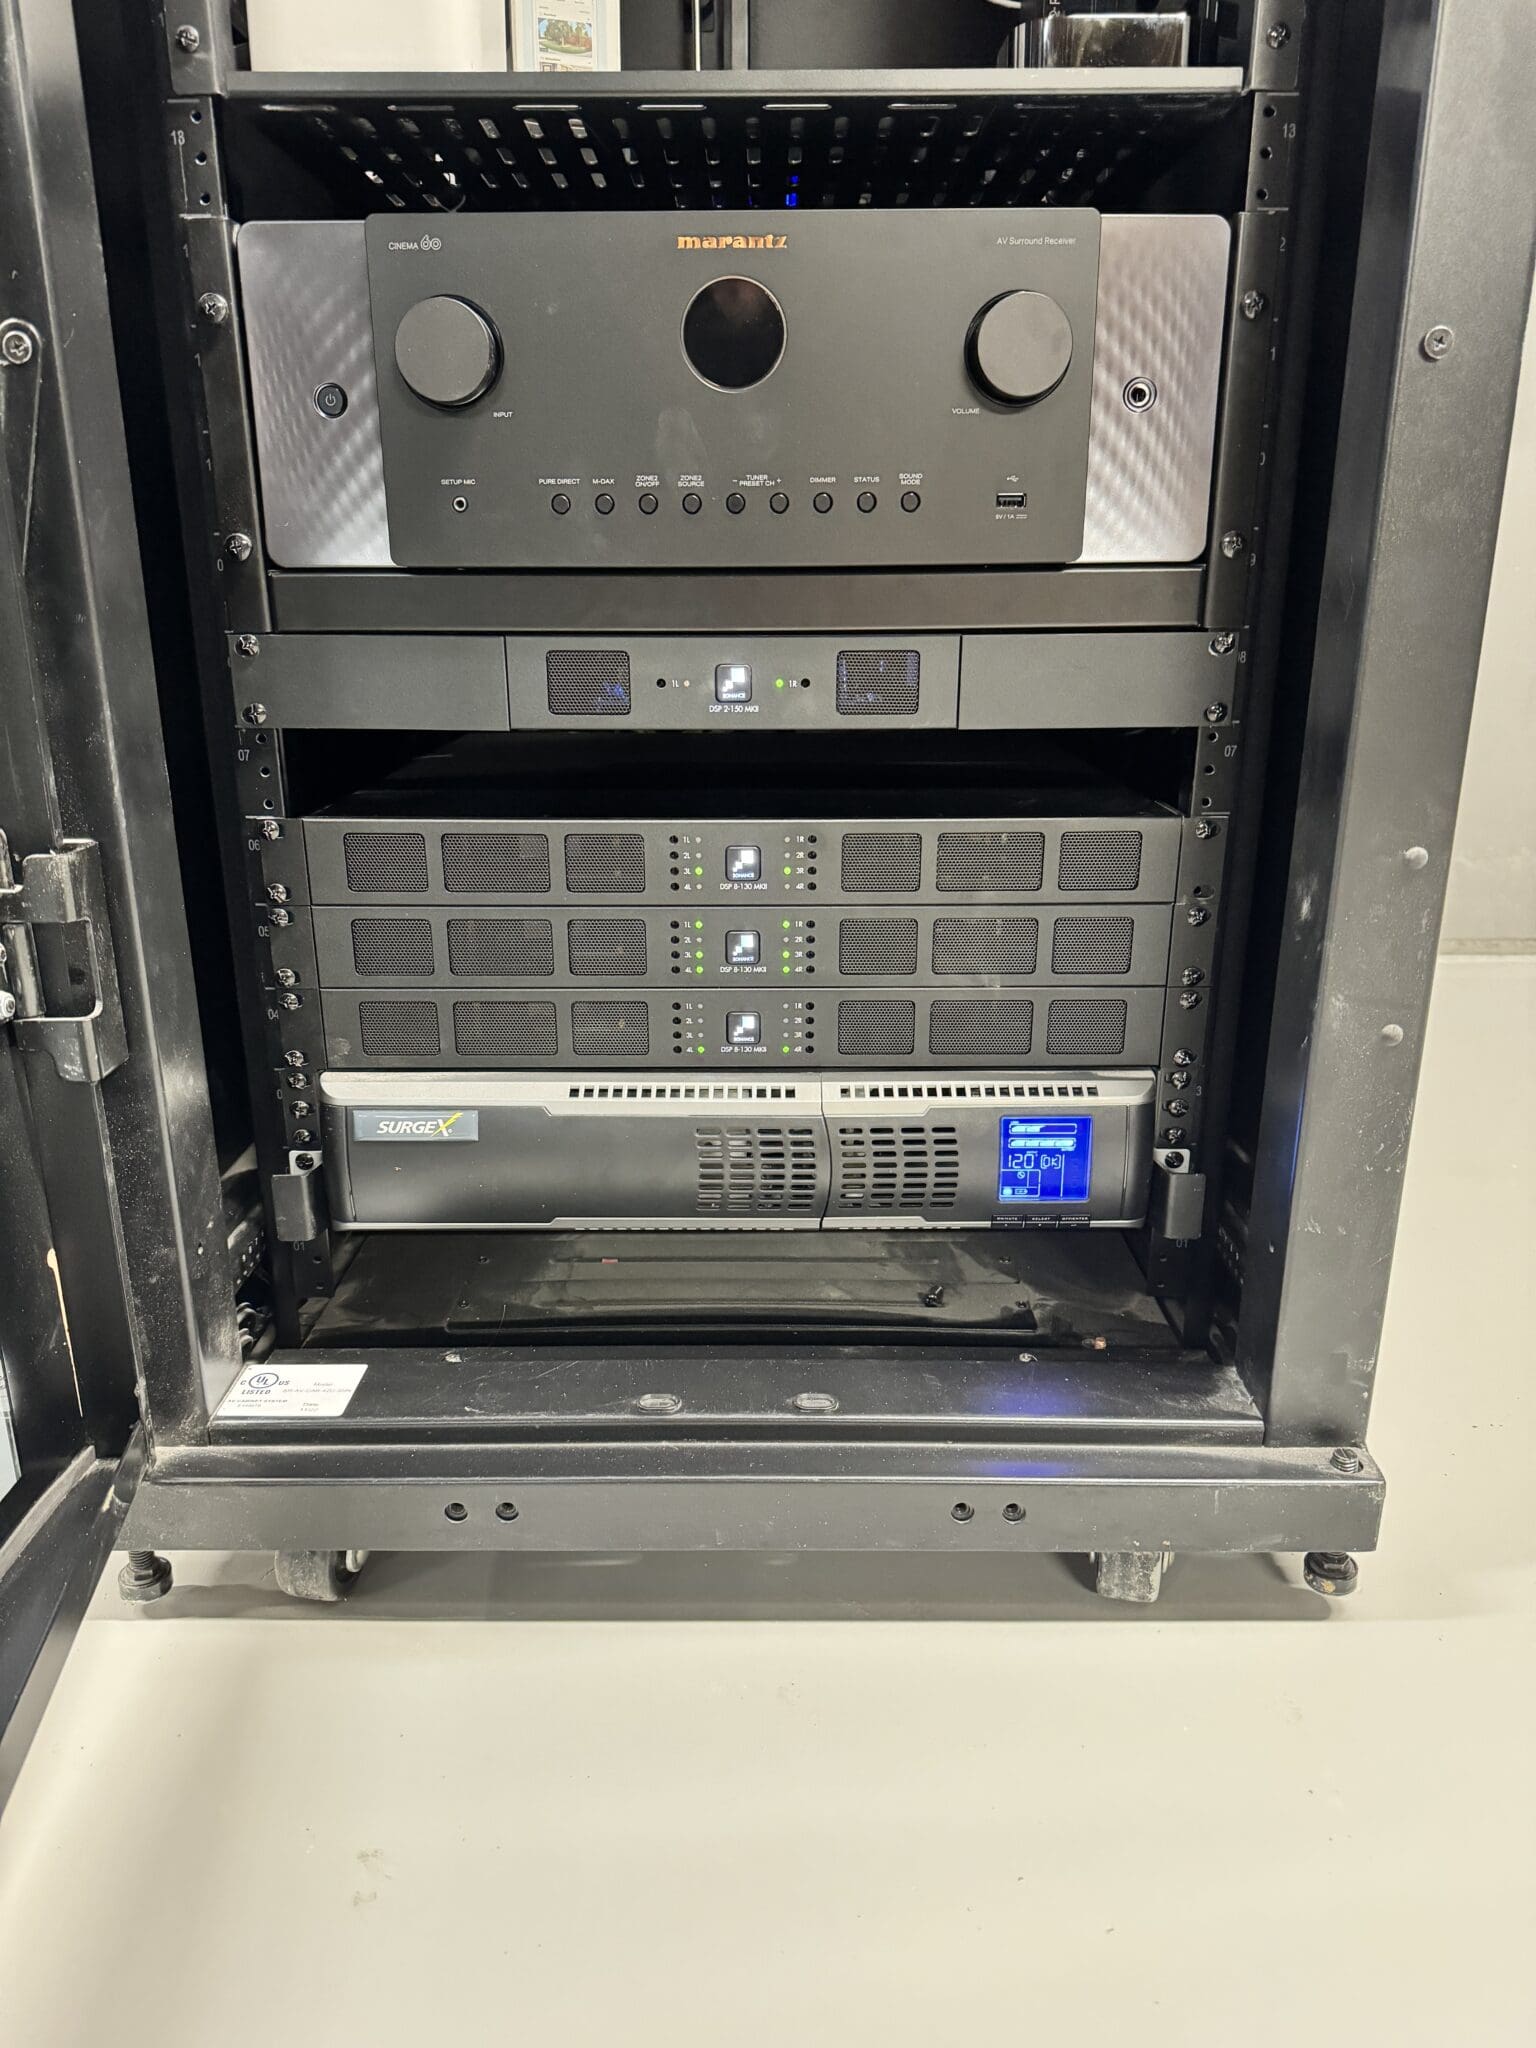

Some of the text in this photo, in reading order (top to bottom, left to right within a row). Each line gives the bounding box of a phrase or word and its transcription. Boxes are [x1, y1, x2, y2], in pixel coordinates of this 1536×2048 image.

[388, 241, 419, 250] CINEMA
[677, 234, 787, 249] marantz
[996, 237, 1008, 245] AV
[1009, 236, 1043, 245] Surround
[1279, 236, 1287, 251] 2
[951, 407, 980, 415] VOLUME
[809, 476, 836, 484] DIMMER
[898, 472, 923, 480] SOUND
[1238, 652, 1247, 664] 8
[789, 680, 797, 688] 1R
[709, 705, 722, 713] DSP
[723, 705, 743, 713] 2-150
[238, 749, 250, 762] 07
[1224, 745, 1237, 758] 07
[377, 1114, 461, 1137] SURGEX
[1008, 1153, 1035, 1169] 120
